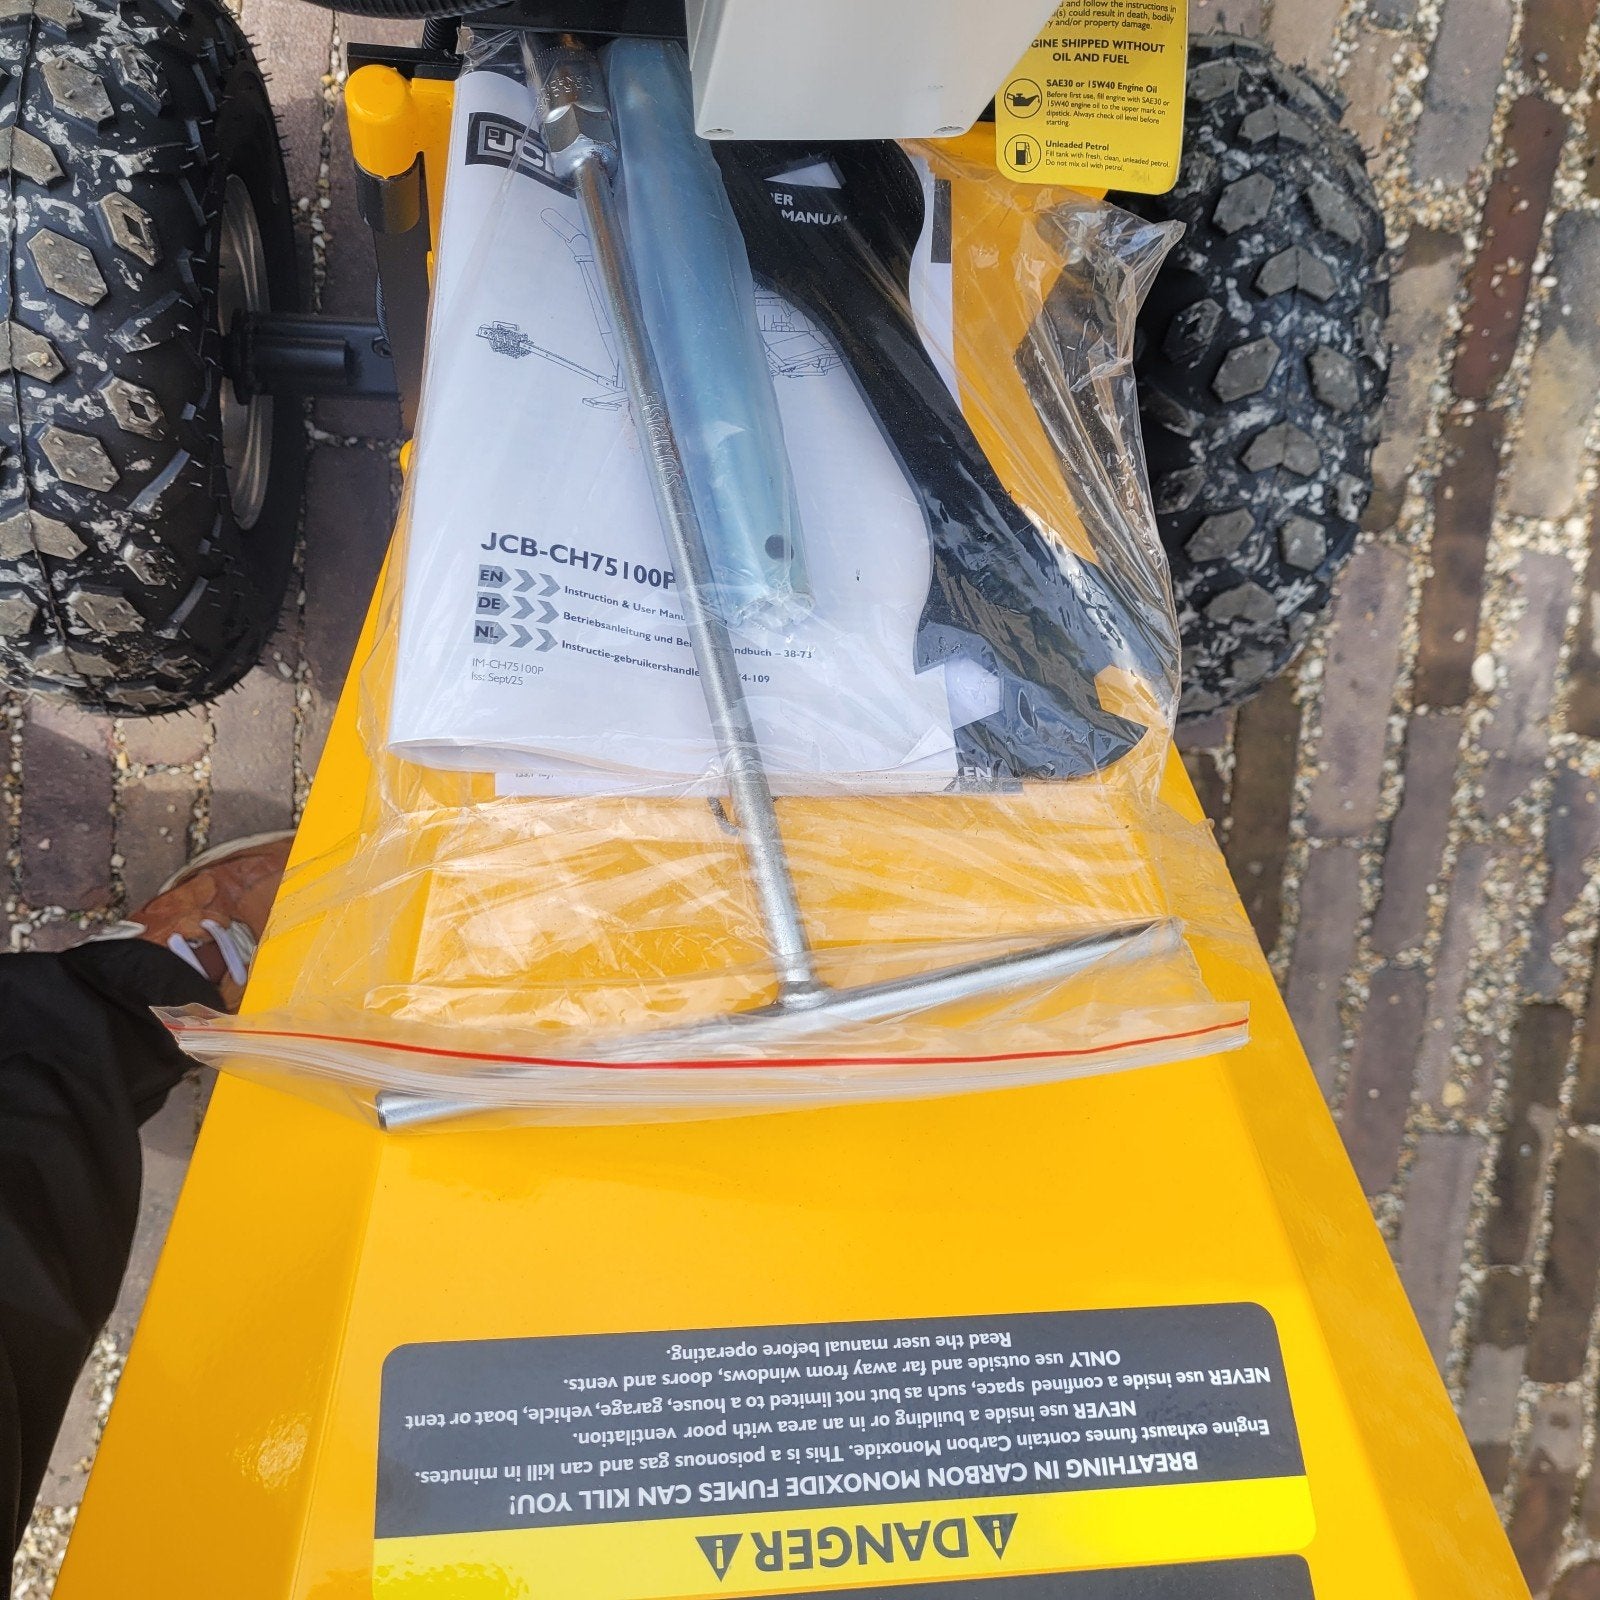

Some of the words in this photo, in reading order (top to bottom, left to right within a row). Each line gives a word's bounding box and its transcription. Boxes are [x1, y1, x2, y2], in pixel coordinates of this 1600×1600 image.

[1126, 1, 1168, 12] instructions
[1170, 5, 1177, 13] in
[1055, 18, 1082, 27] and/or
[1084, 20, 1119, 29] property
[1121, 19, 1153, 31] damage.
[1068, 9, 1091, 17] could
[1092, 9, 1116, 17] result
[1117, 10, 1125, 18] in
[1126, 10, 1150, 21] death,
[1152, 12, 1175, 24] bodily
[1030, 38, 1059, 48] GINE
[1061, 38, 1110, 49] SHIPPED
[1112, 40, 1165, 53] WITHOUT
[1052, 52, 1071, 62] OIL
[1073, 52, 1100, 62] AND
[1102, 52, 1130, 64] FUEL
[1046, 79, 1074, 88] SAE30
[1088, 80, 1115, 90] 15W40
[1117, 82, 1144, 93] Engine
[1146, 85, 1158, 94] Oil
[1047, 99, 1070, 108] 15W40
[1070, 102, 1091, 110] engine
[1110, 103, 1120, 111] the
[1121, 105, 1139, 113] upper
[1140, 107, 1156, 115] mark
[1069, 91, 1082, 99] first
[1106, 94, 1126, 103] engine
[1127, 96, 1141, 104] with
[1141, 96, 1162, 105] SAE30
[1046, 119, 1071, 128] starting.
[1073, 110, 1095, 119] Always
[1096, 111, 1114, 120] check
[1124, 114, 1139, 122] level
[1140, 116, 1160, 125] before
[1045, 140, 1083, 149] Unleaded
[1085, 142, 1110, 151] Petrol
[1045, 158, 1055, 166] Do
[1090, 162, 1103, 170] with
[1056, 150, 1069, 158] tank
[1071, 151, 1084, 159] with
[1122, 156, 1149, 165] unleaded
[770, 192, 793, 206] ER
[781, 209, 847, 225] MANUA
[480, 532, 677, 590] JCB-CH75100P
[480, 569, 503, 583] EN
[478, 596, 500, 610] DE
[564, 585, 619, 607] Instruction
[621, 600, 630, 609] &
[633, 603, 656, 616] User
[475, 625, 498, 640] NL
[563, 612, 651, 641] Betriebsanleitung
[654, 633, 673, 645] und
[472, 658, 544, 675] IM-CH75100P
[561, 640, 701, 677] Instructie-gebruikershandle
[739, 673, 770, 683] 4-109
[488, 672, 523, 686] Sept/25
[824, 1338, 889, 1357] manual
[892, 1336, 931, 1349] user
[935, 1334, 965, 1351] the
[968, 1331, 1012, 1350] Read
[665, 1340, 758, 1364] operating.
[762, 1341, 820, 1359] before
[1034, 1352, 1064, 1366] use
[1069, 1349, 1121, 1368] ONLY
[805, 1364, 850, 1381] from
[852, 1358, 898, 1376] away
[901, 1359, 928, 1377] far
[930, 1357, 963, 1376] and
[967, 1354, 1031, 1373] outside
[563, 1376, 619, 1393] vents.
[623, 1374, 657, 1392] and
[660, 1371, 713, 1388] doors
[718, 1366, 802, 1385] windows,
[1106, 1375, 1119, 1388] a
[1122, 1372, 1173, 1391] inside
[1175, 1370, 1205, 1384] use
[1207, 1366, 1272, 1386] NEVER
[903, 1386, 923, 1399] as
[927, 1383, 967, 1402] such
[971, 1376, 1025, 1395] space,
[1031, 1376, 1104, 1396] confined
[730, 1396, 742, 1409] a
[745, 1395, 766, 1410] to
[769, 1391, 832, 1411] limited
[835, 1389, 866, 1406] not
[869, 1387, 902, 1404] but
[595, 1396, 663, 1416] garage,
[666, 1397, 726, 1414] house,
[1039, 1403, 1069, 1417] use
[1072, 1399, 1137, 1420] NEVER
[404, 1413, 447, 1431] tent
[449, 1411, 472, 1425] or
[474, 1409, 518, 1426] boat
[522, 1405, 594, 1425] vehicle,
[822, 1417, 844, 1430] an
[849, 1415, 866, 1433] in
[870, 1414, 891, 1427] or
[894, 1408, 966, 1429] building
[968, 1409, 980, 1422] a
[984, 1405, 1036, 1425] inside
[683, 1419, 727, 1439] poor
[732, 1421, 774, 1440] with
[776, 1418, 818, 1433] area
[1140, 1422, 1209, 1441] exhaust
[1211, 1415, 1271, 1438] Engine
[572, 1426, 678, 1448] ventilation.
[946, 1434, 1012, 1454] Carbon
[1016, 1430, 1081, 1451] contain
[1084, 1427, 1139, 1444] fumes
[674, 1445, 766, 1469] poisonous
[769, 1449, 782, 1462] a
[786, 1448, 801, 1465] is
[805, 1445, 845, 1464] This
[848, 1439, 942, 1461] Monoxide.
[560, 1460, 594, 1475] can
[599, 1458, 634, 1478] and
[638, 1451, 670, 1470] gas
[1065, 1450, 1199, 1479] BREATHING
[414, 1466, 498, 1486] minutes.
[503, 1465, 521, 1483] in
[526, 1463, 555, 1482] kill
[926, 1462, 1028, 1488] CARBON
[1033, 1459, 1060, 1481] IN
[698, 1477, 779, 1503] FUMES
[785, 1468, 921, 1497] MONOXIDE
[509, 1491, 574, 1516] YOU!
[578, 1487, 630, 1511] KILL
[637, 1483, 692, 1507] CAN
[750, 1517, 970, 1573] DANGER
